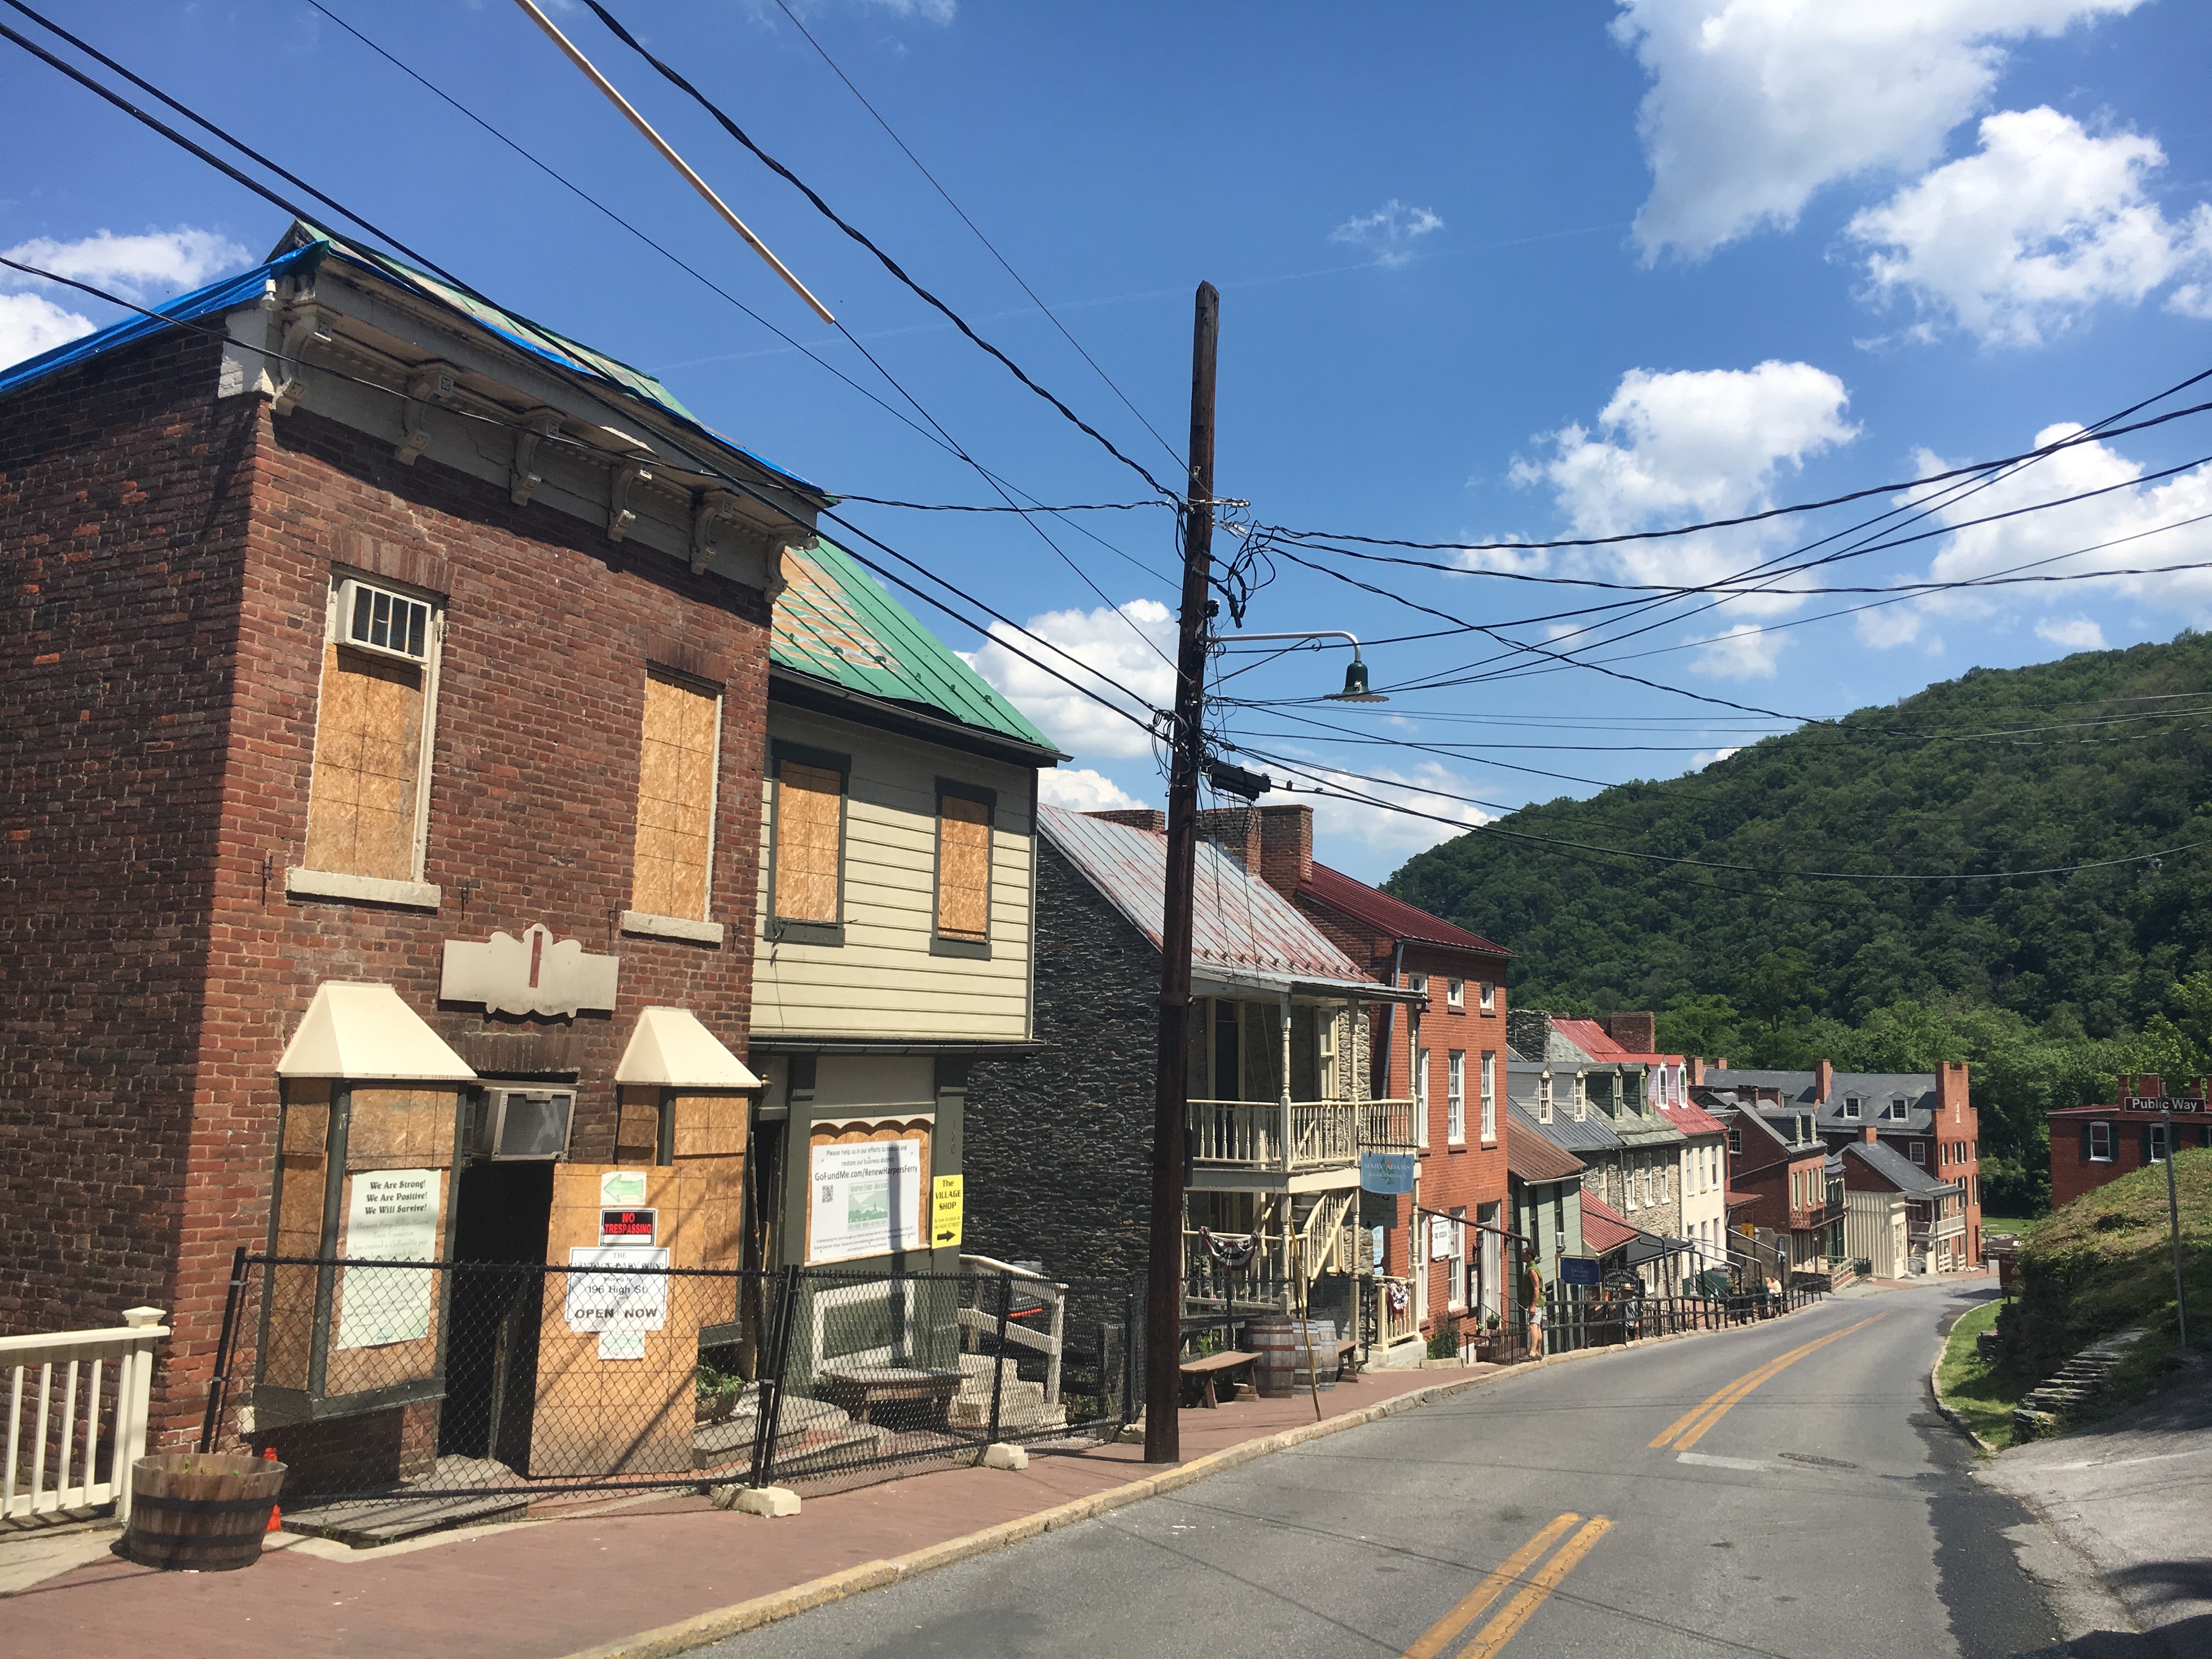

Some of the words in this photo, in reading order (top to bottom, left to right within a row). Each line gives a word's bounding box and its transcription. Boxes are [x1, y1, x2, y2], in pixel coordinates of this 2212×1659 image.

[2132, 1098, 2169, 1109] Public
[2172, 1099, 2197, 1112] Way
[815, 1165, 917, 1181] GoFundMe.com/RenewHarpersFerry
[399, 1180, 426, 1189] Strong!
[380, 1193, 394, 1201] Are
[396, 1192, 427, 1200] Positive!
[935, 1190, 961, 1199] VILLAGE
[379, 1205, 395, 1214] Will
[397, 1203, 427, 1213] Survive!
[939, 1201, 957, 1210] SHOP
[622, 1213, 635, 1223] NO
[605, 1224, 652, 1234] TRESPASSING
[364, 1241, 383, 1250] created
[1605, 1271, 1621, 1279] COACH
[609, 1286, 630, 1295] High
[574, 1308, 614, 1318] OPEN
[624, 1308, 657, 1318] NOW
